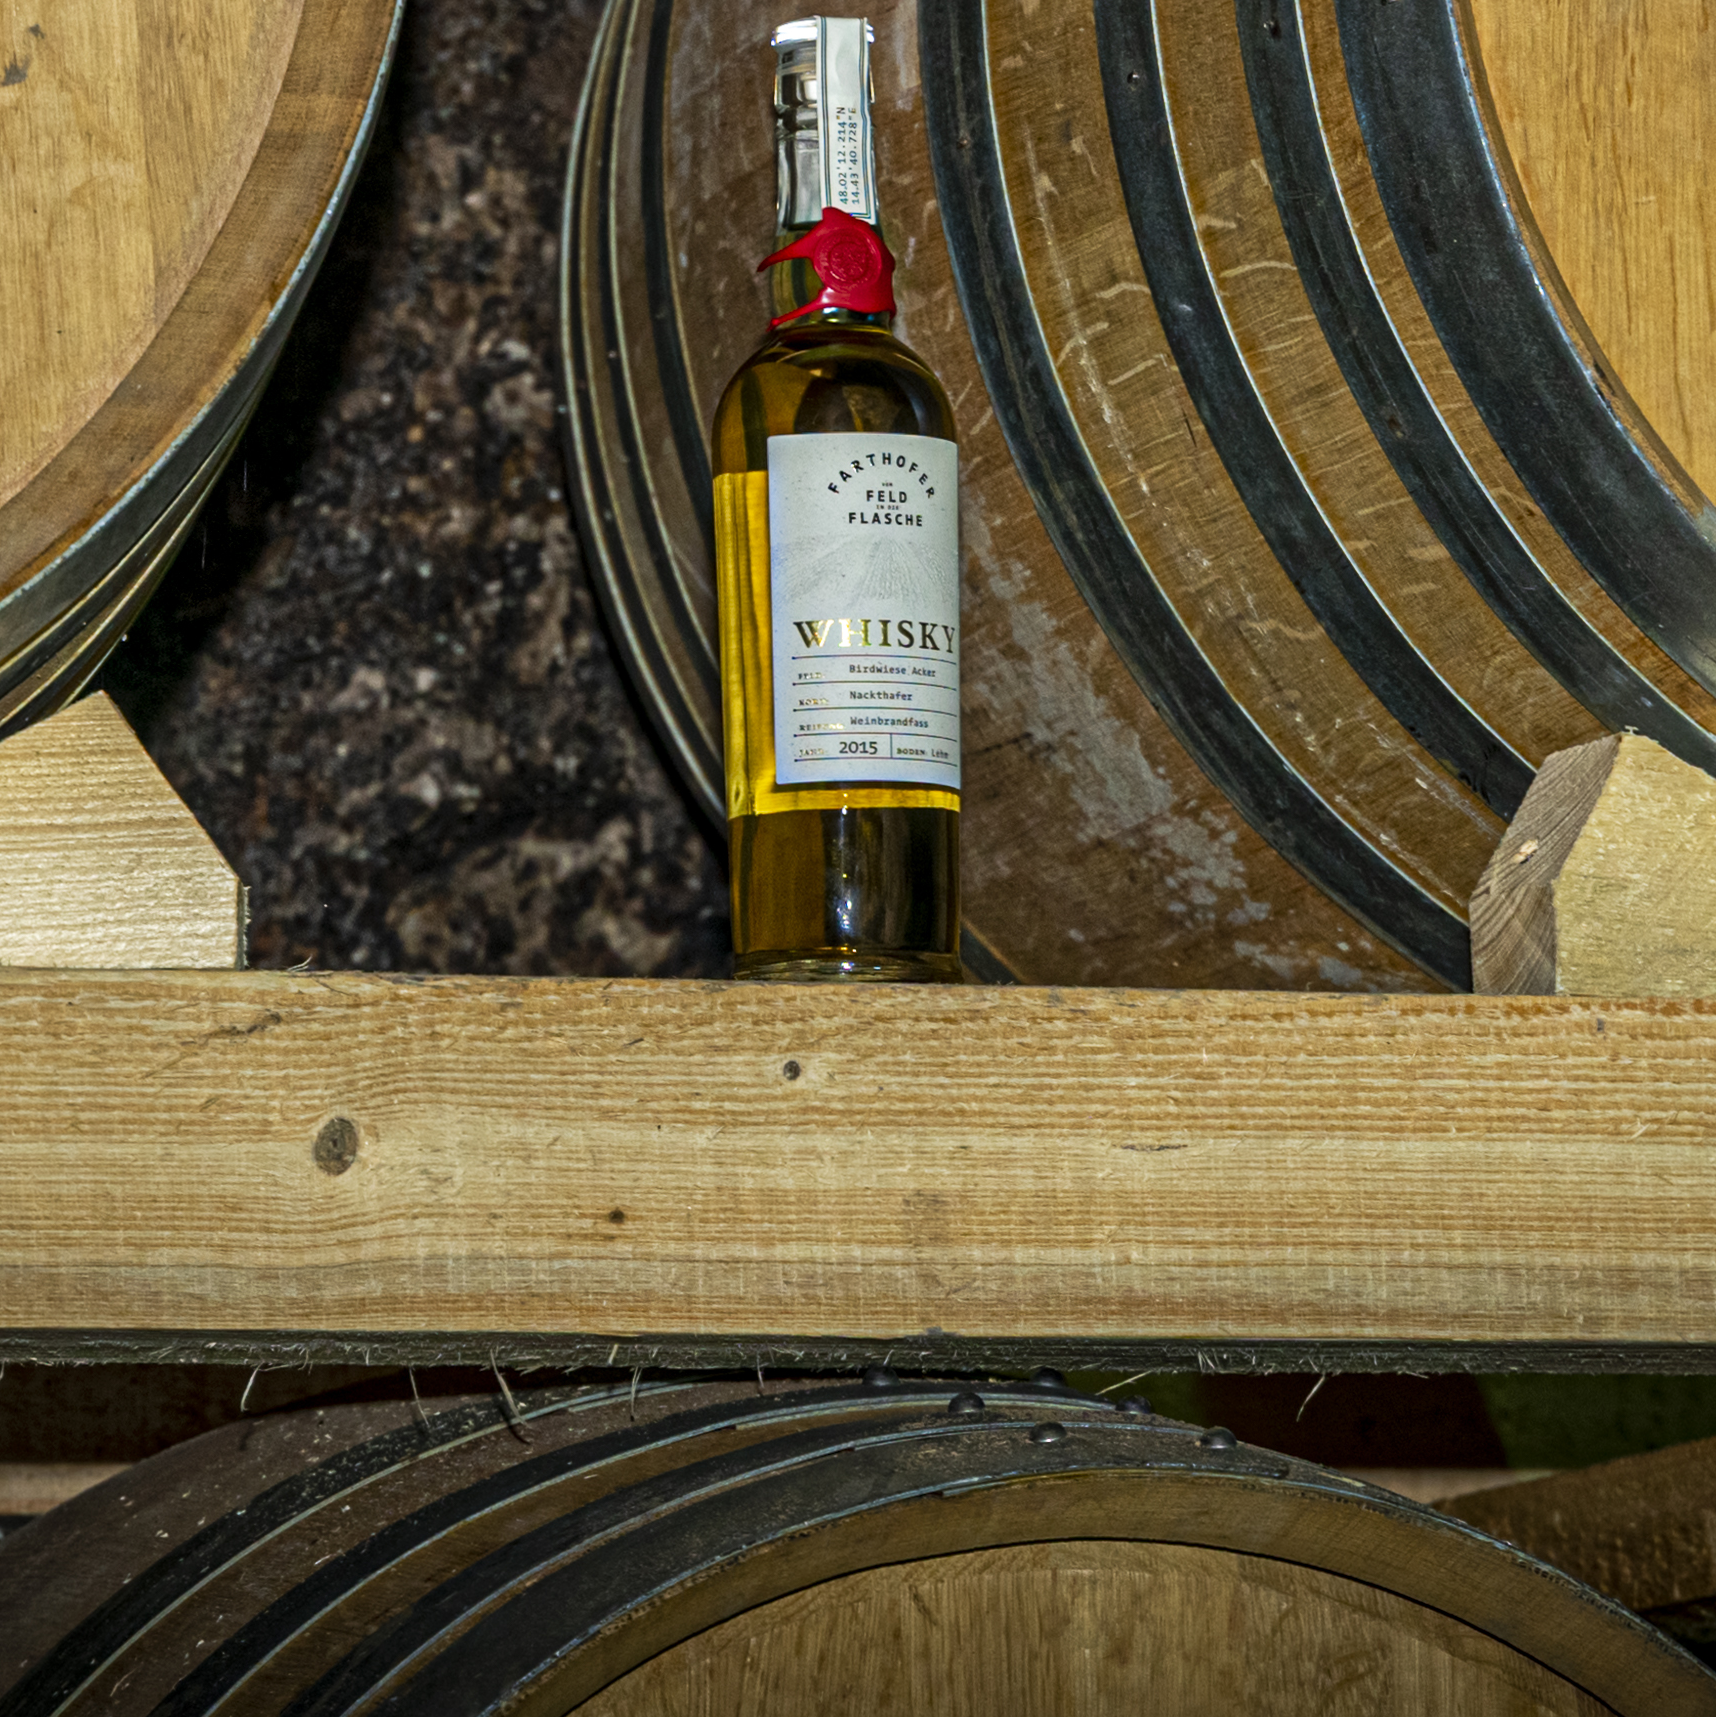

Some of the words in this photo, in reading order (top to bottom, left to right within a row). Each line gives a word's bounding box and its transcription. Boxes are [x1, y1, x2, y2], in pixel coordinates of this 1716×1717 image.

[827, 452, 935, 499] FARTHOFER
[866, 489, 908, 503] FELD
[848, 512, 923, 527] FLASCHE
[793, 618, 956, 654] WHISKY
[849, 663, 907, 676] Birdwiese
[911, 666, 936, 678] Acker
[849, 690, 913, 702] Nackthafer
[850, 716, 929, 729] Weinbrandfass
[839, 740, 878, 756] 2015
